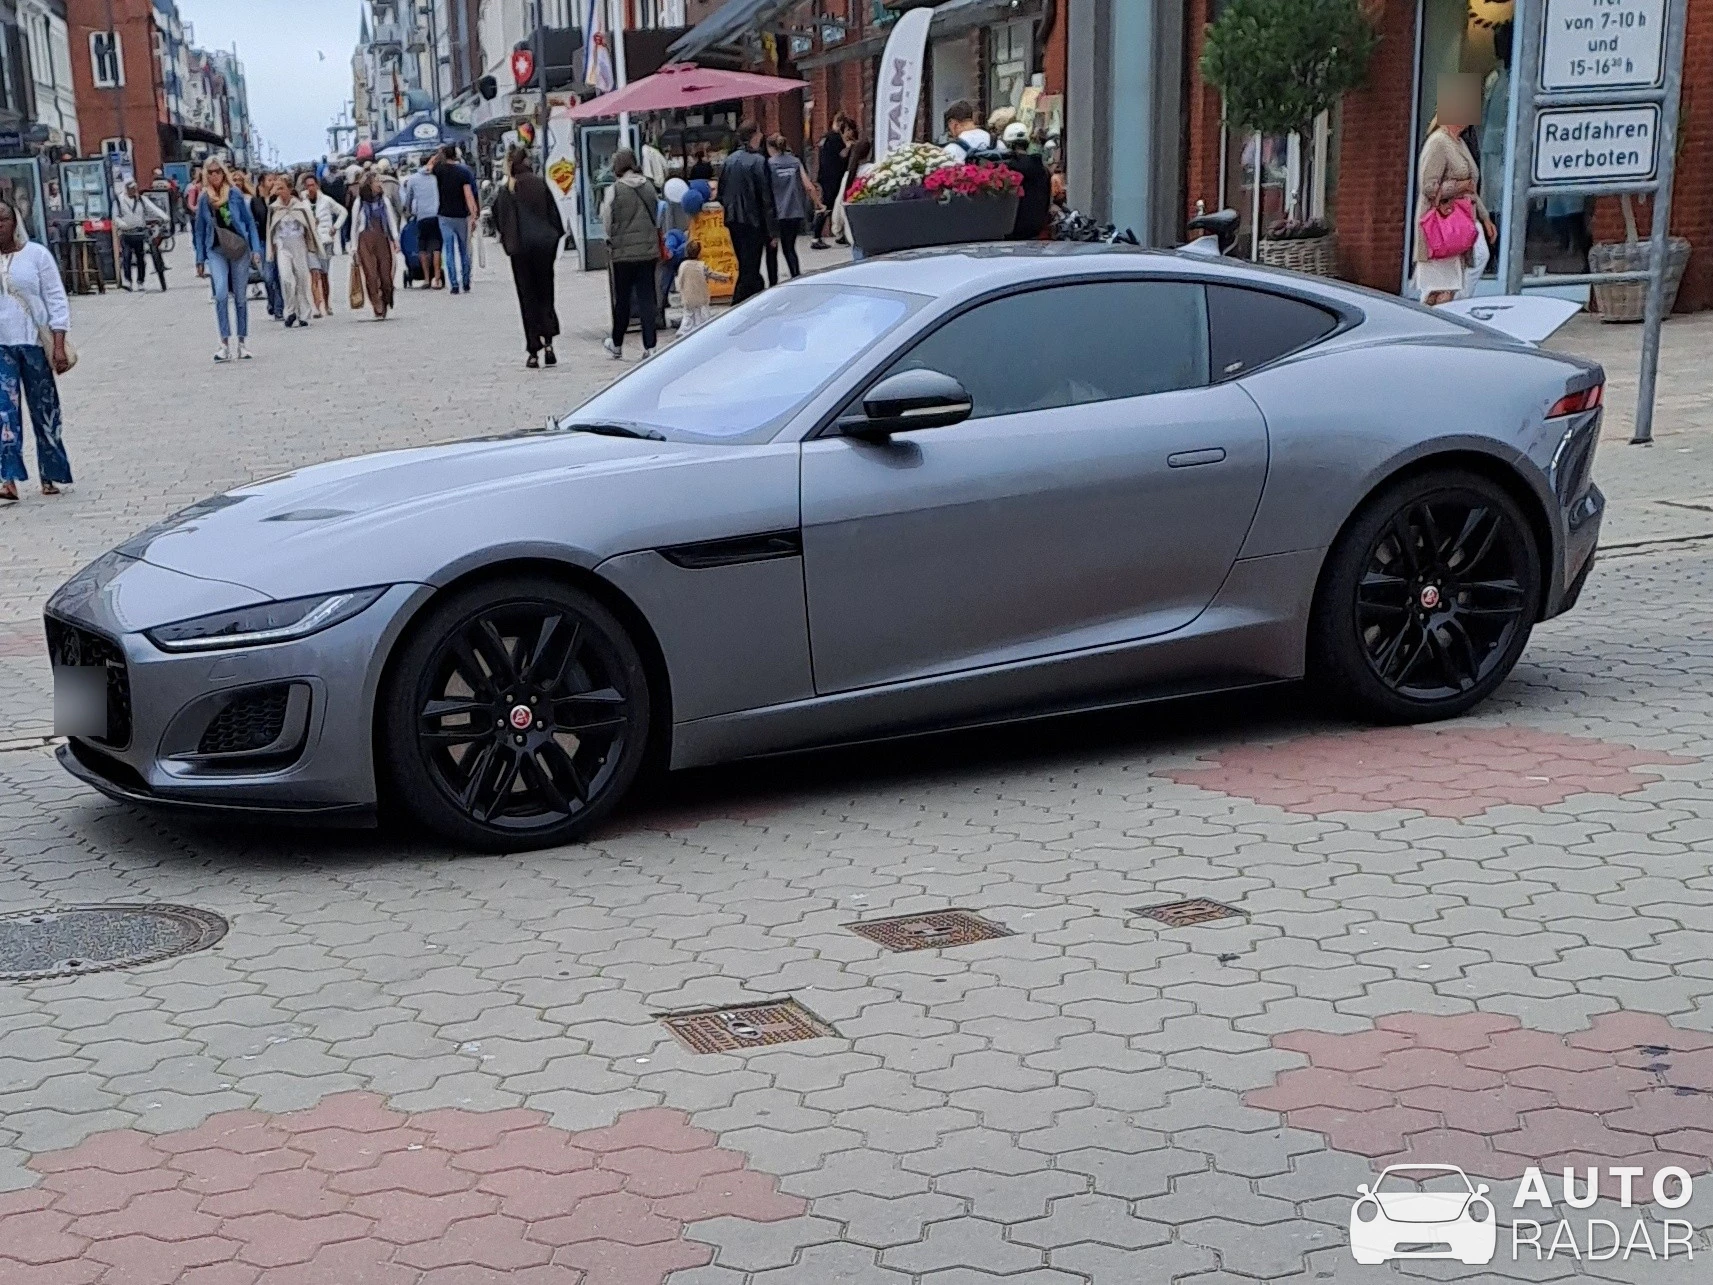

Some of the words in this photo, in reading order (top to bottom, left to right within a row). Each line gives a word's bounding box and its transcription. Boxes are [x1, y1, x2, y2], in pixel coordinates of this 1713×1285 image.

[1565, 16, 1594, 30] von
[1601, 12, 1635, 29] 7-10
[1638, 11, 1647, 27] h
[1588, 35, 1619, 52] und
[1626, 58, 1634, 73] h
[1545, 121, 1648, 143] Radfahren
[1552, 149, 1639, 169] verboten
